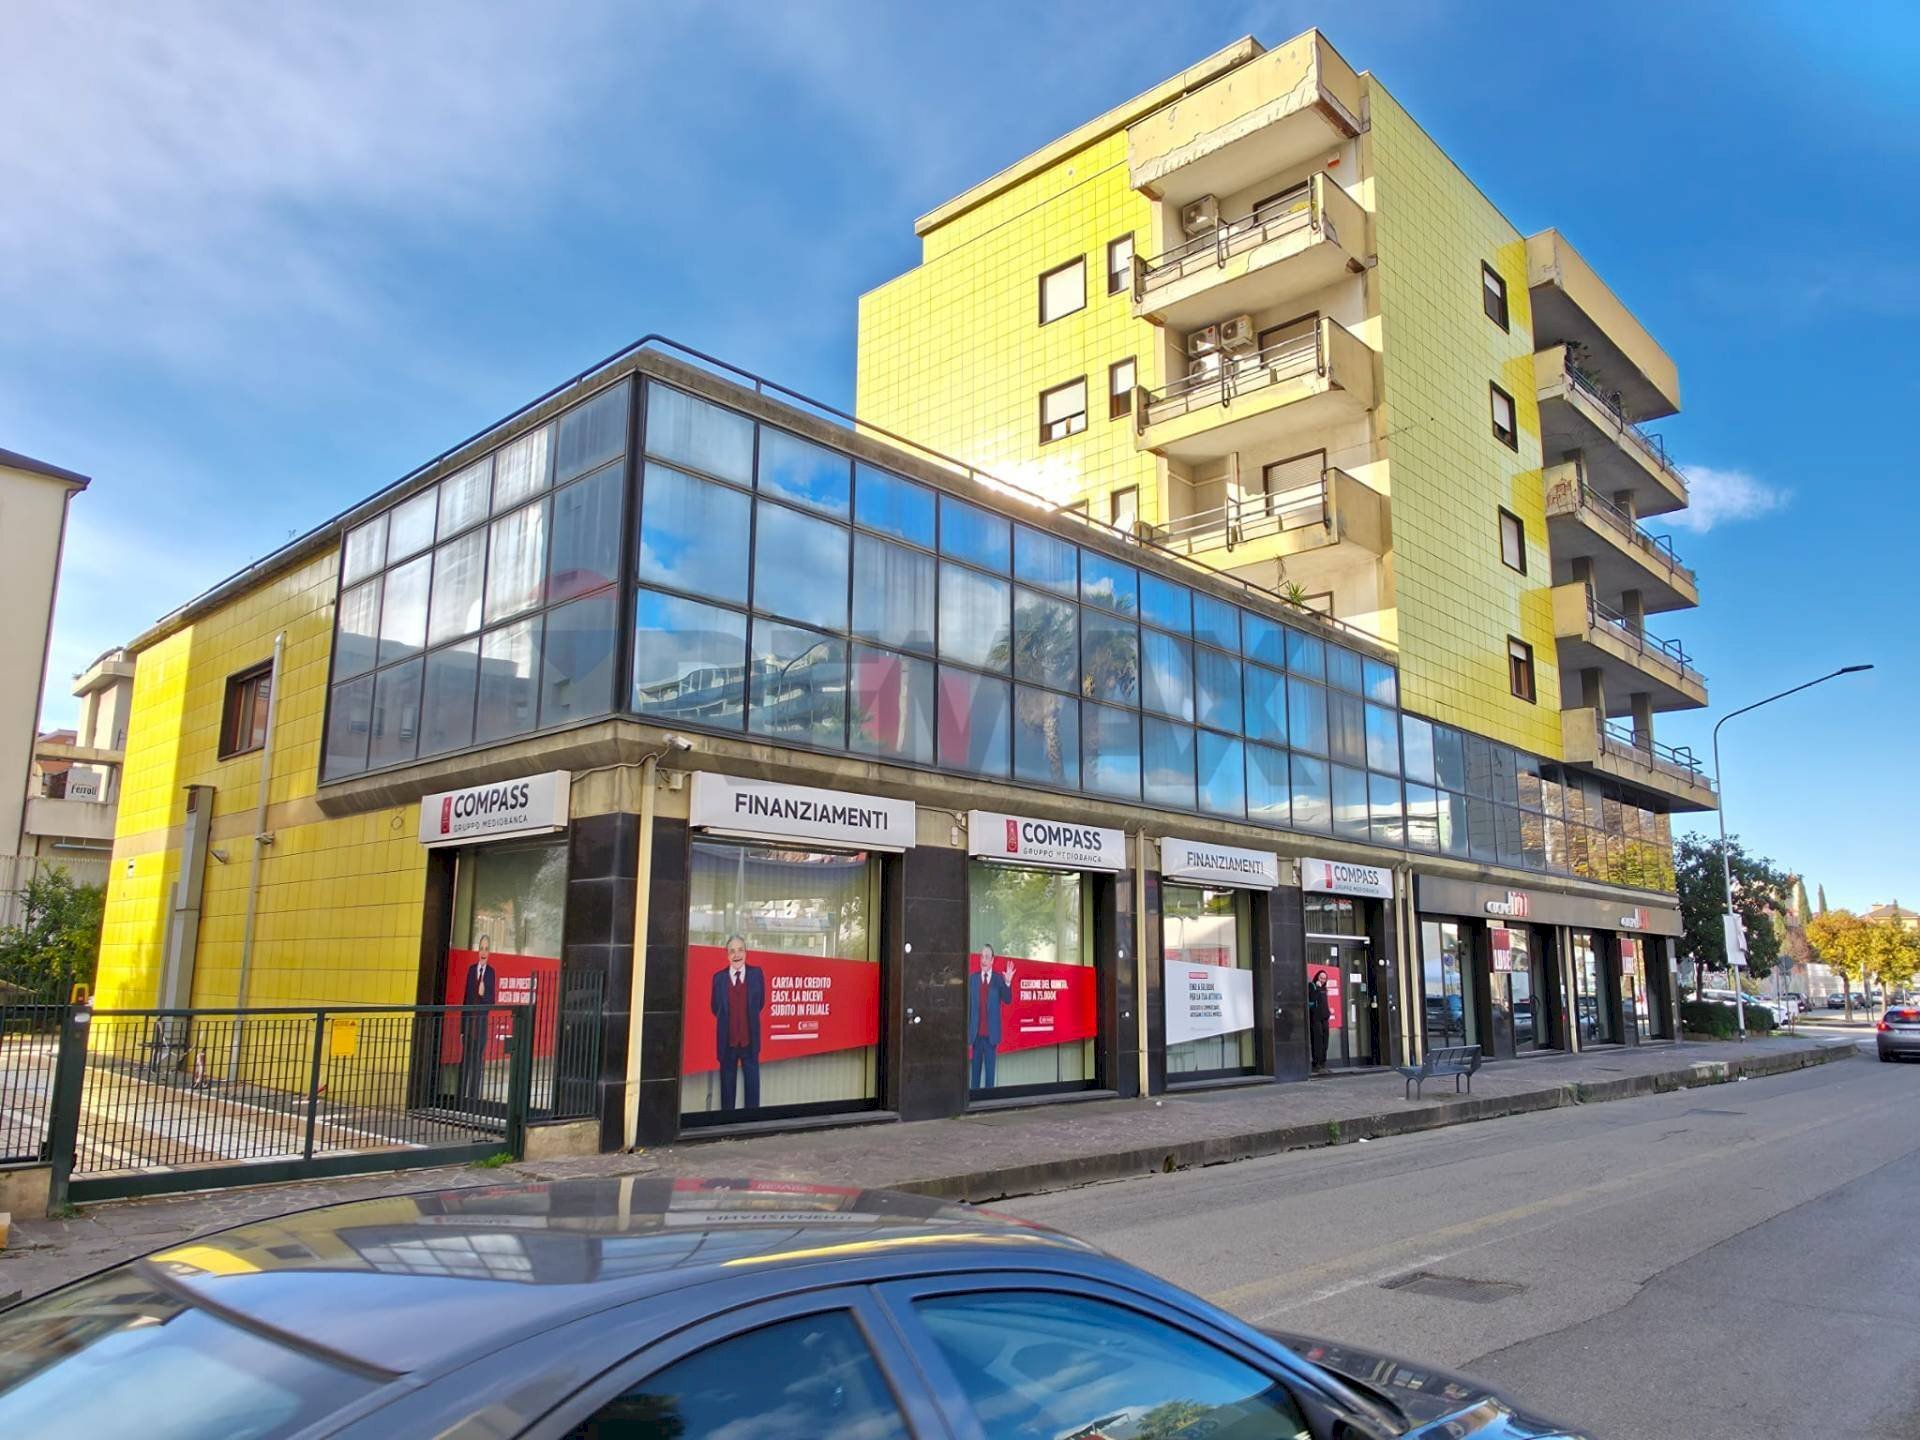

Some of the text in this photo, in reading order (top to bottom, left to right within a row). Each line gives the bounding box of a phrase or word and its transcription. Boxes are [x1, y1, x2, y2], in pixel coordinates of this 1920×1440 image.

[453, 783, 530, 818] COMPASS
[735, 792, 889, 830] FINANZIAMENTI
[453, 815, 529, 833] GRUPPO MEDIOBANCA
[1022, 822, 1103, 851] COMPASS
[1023, 847, 1102, 863] GRUPPO MEDIOBANCA
[1187, 851, 1264, 874] FINANZIAMENTI
[1334, 865, 1379, 885] COMPASS
[772, 976, 832, 989] CARTA DI CREDITO
[771, 990, 823, 1002] EASY. LA RICEVI
[771, 1003, 830, 1016] SUBITO IN FILIALE
